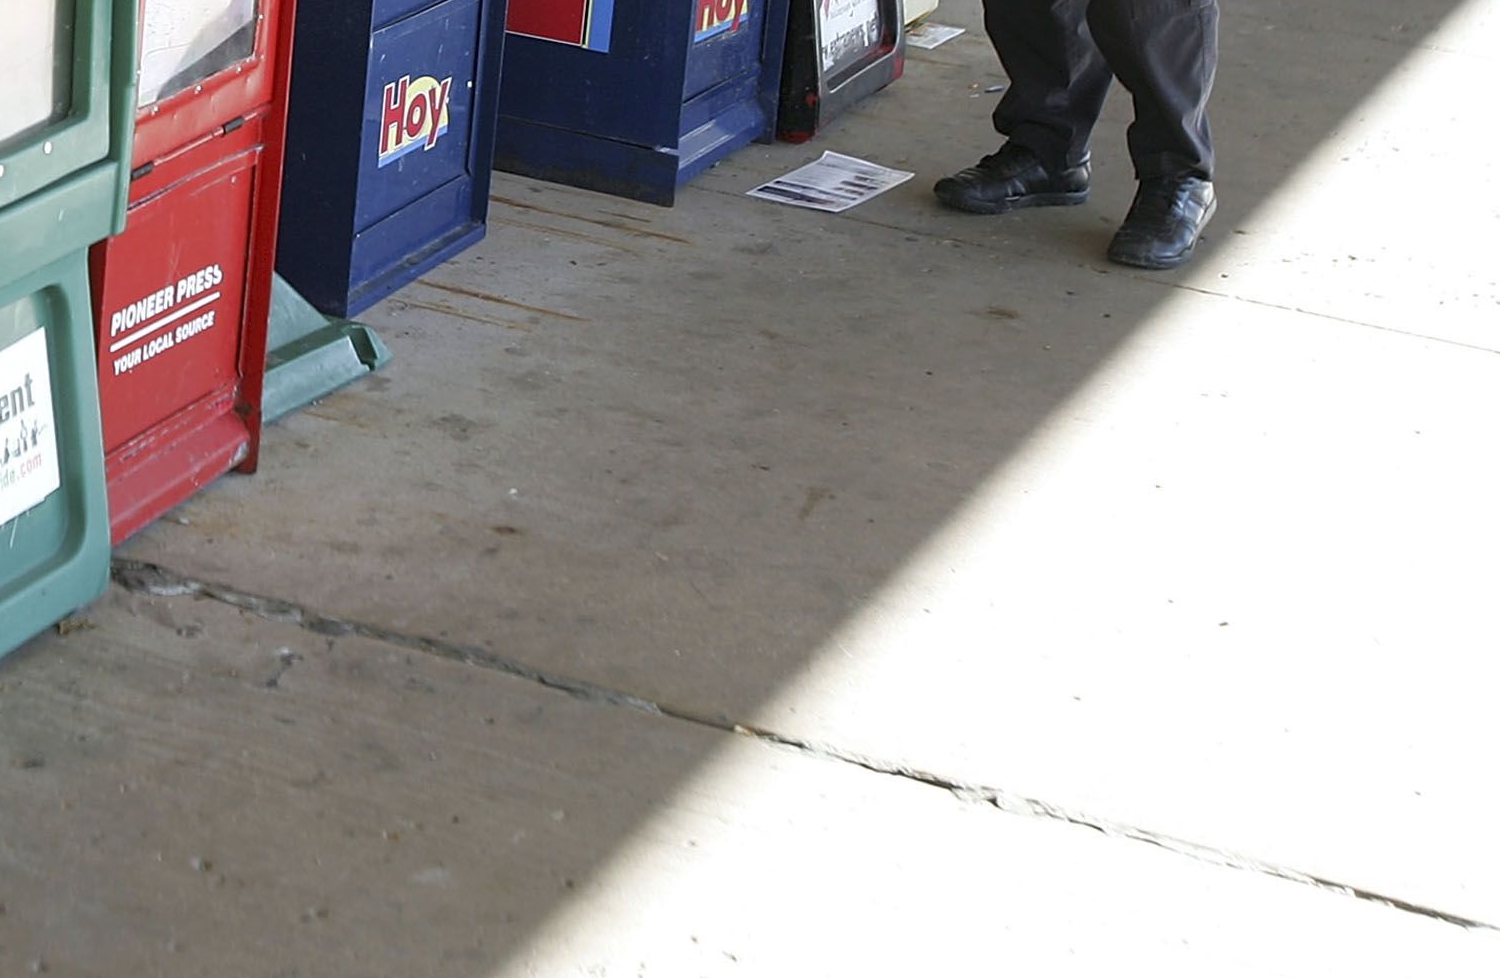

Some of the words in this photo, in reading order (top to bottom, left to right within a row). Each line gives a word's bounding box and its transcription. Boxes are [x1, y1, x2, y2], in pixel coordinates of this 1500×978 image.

[379, 75, 453, 156] Hoy
[111, 285, 175, 337] PIONEER
[176, 264, 223, 303] PRESS
[114, 347, 142, 375] YOUR
[143, 332, 174, 361] LOCAL
[176, 310, 215, 343] SOURCE
